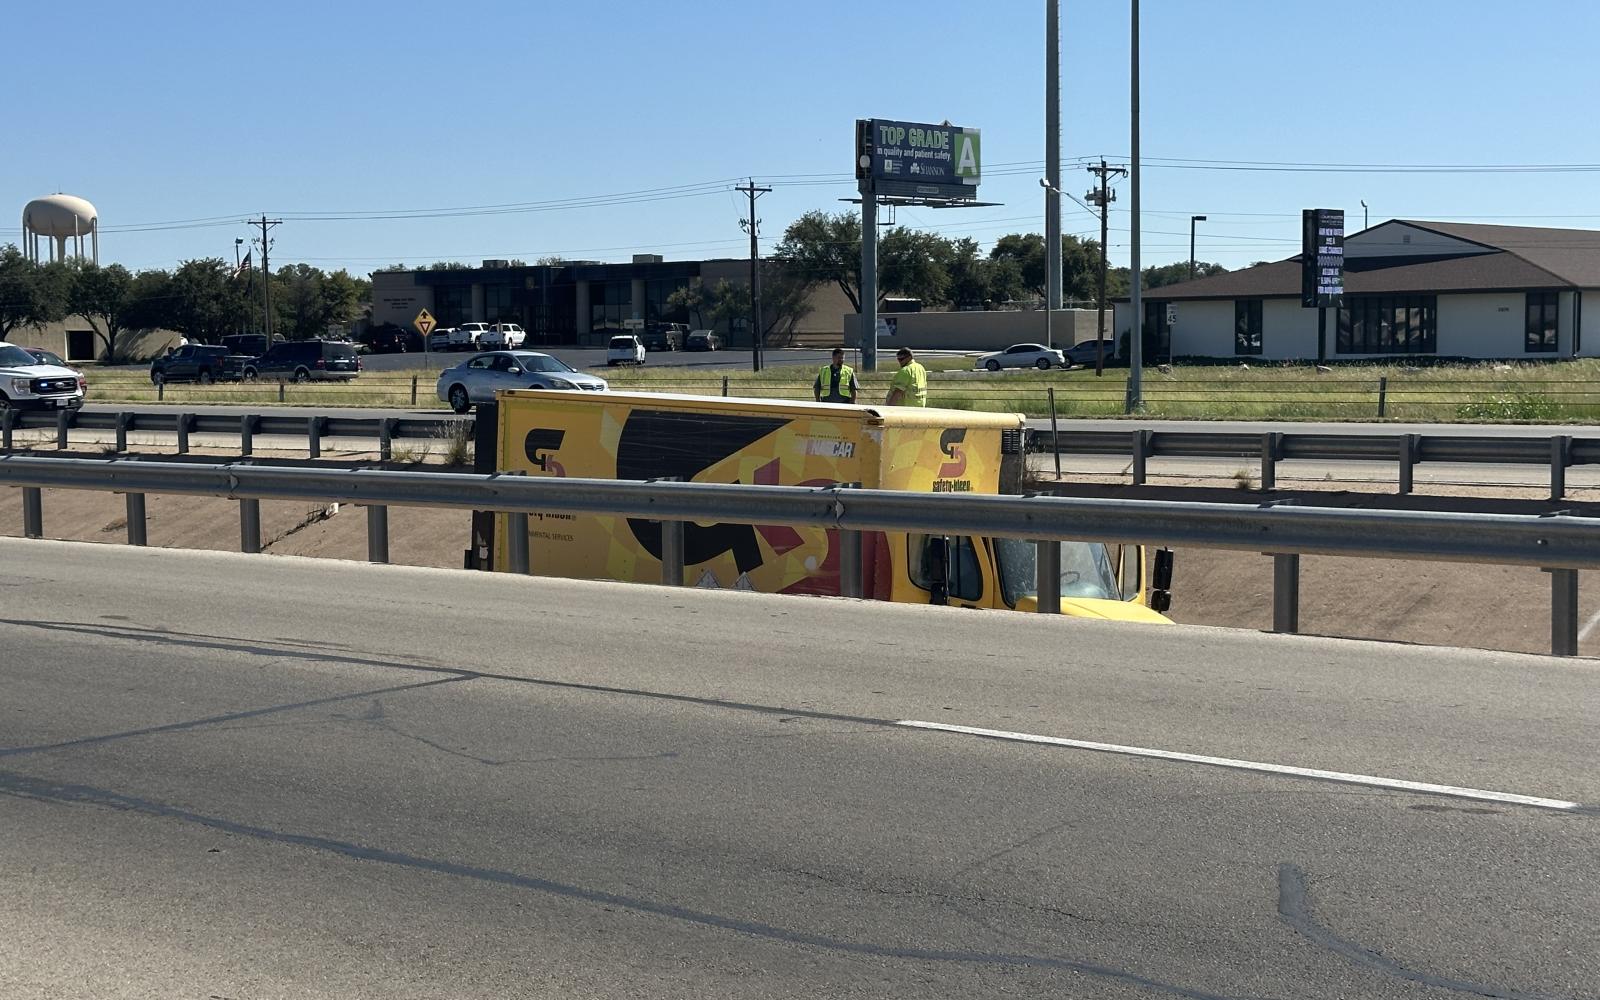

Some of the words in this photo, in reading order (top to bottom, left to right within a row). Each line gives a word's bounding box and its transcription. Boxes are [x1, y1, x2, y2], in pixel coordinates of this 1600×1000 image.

[880, 126, 904, 145] TOP
[909, 128, 949, 149] GRADE
[884, 146, 903, 158] quality
[903, 148, 914, 157] and
[914, 149, 934, 159] patient
[957, 137, 977, 175] A
[1167, 314, 1177, 323] 45
